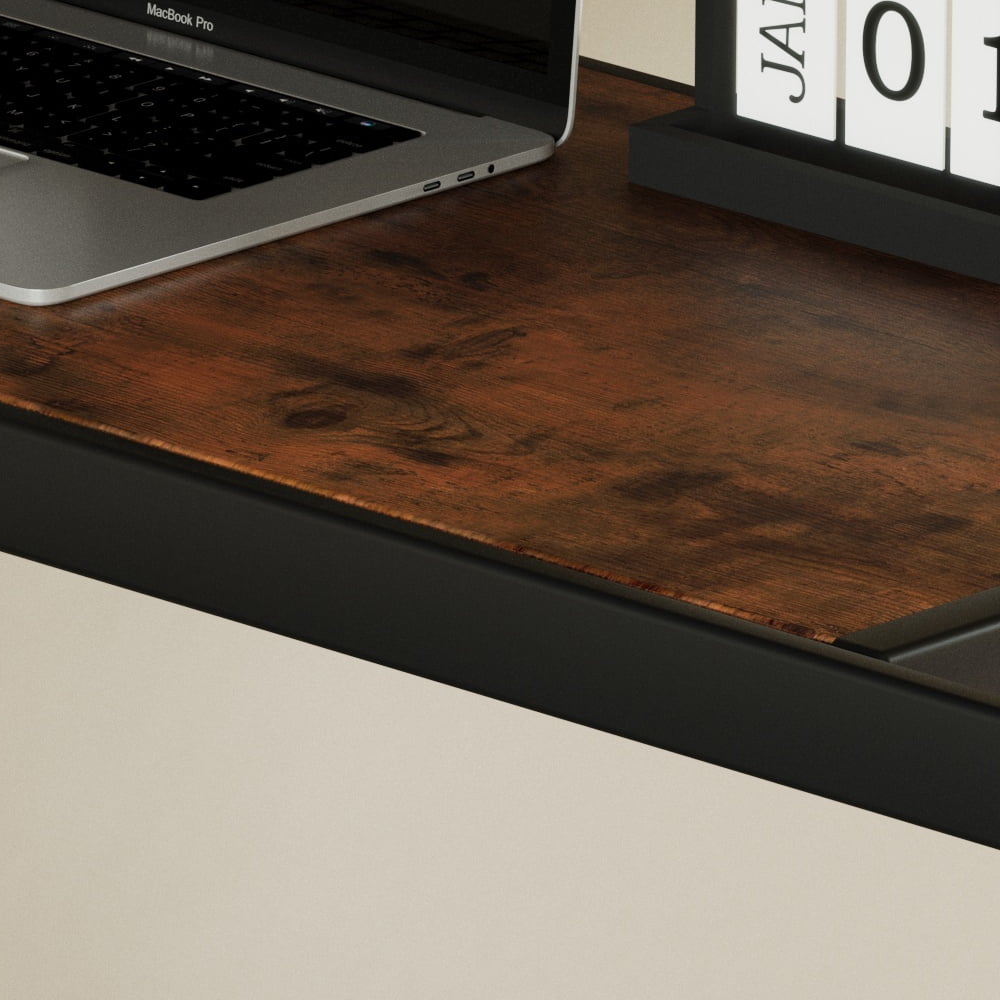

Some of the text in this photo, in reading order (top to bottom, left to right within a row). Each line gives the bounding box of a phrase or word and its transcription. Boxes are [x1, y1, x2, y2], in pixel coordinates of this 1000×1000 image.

[146, 2, 214, 32] MacBook Pro
[862, 0, 925, 101] 0
